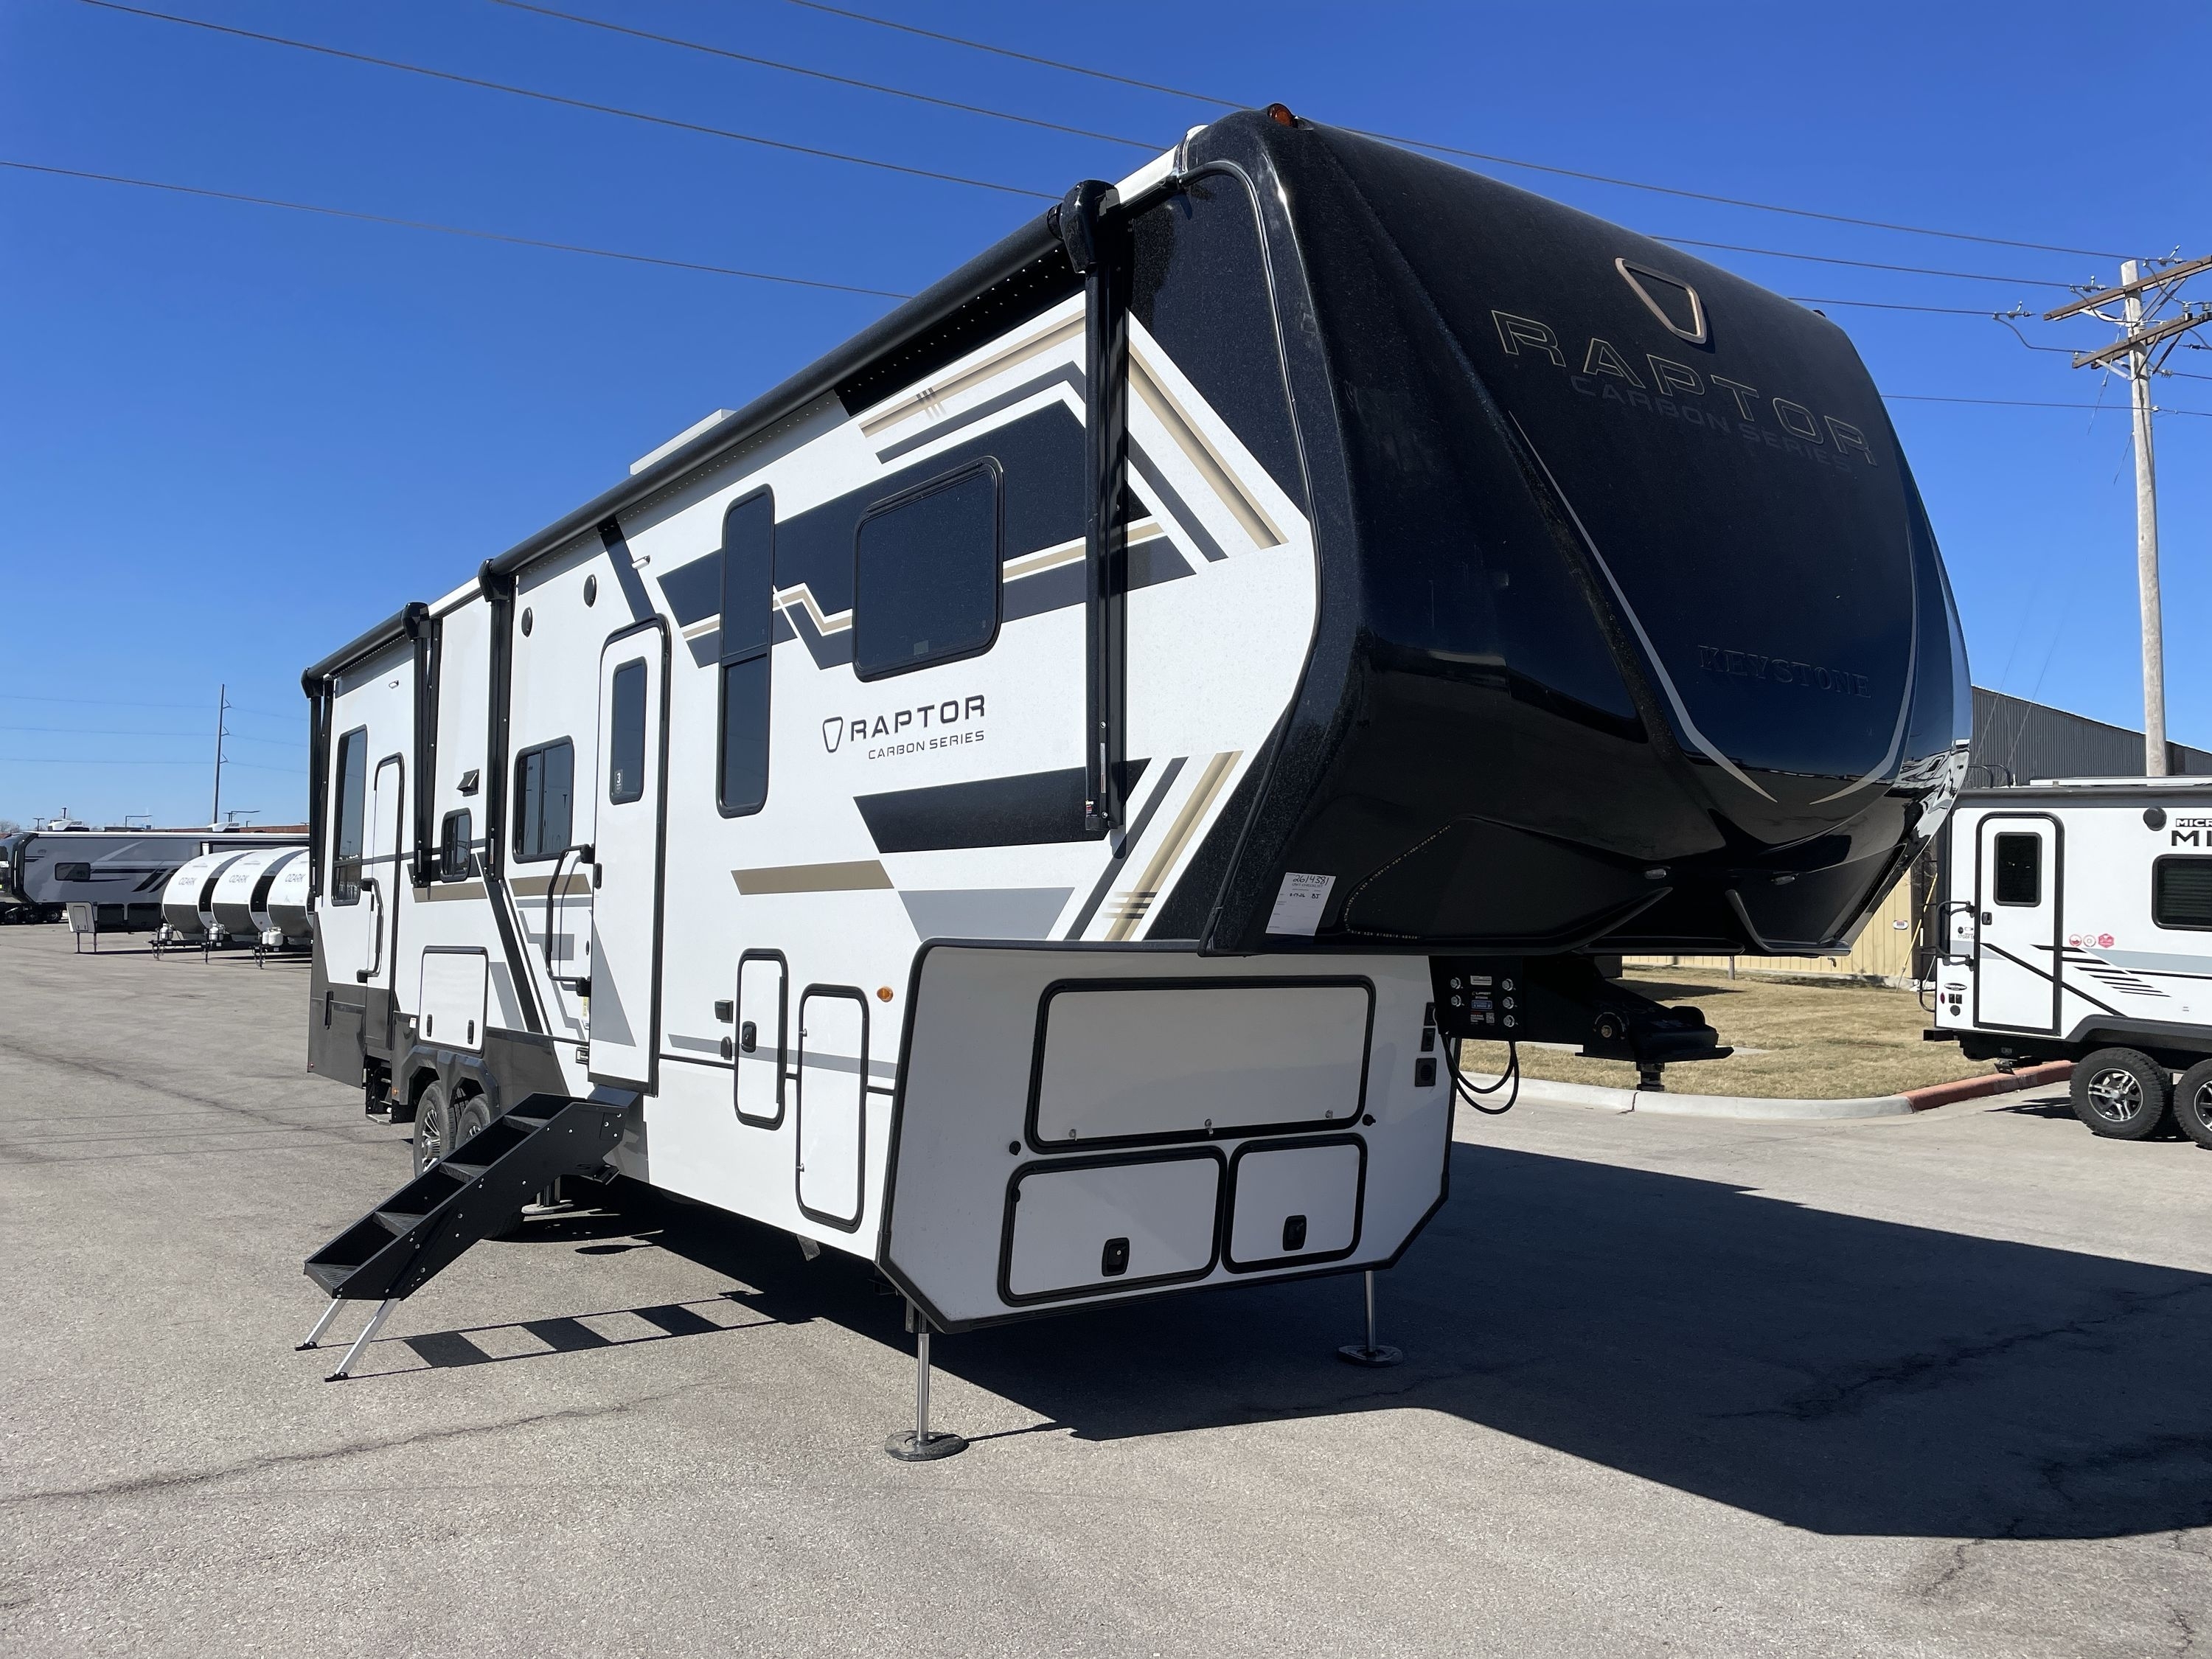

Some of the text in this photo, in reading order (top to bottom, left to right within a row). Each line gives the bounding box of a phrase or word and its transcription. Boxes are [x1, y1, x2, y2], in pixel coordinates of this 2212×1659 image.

[1491, 309, 1877, 467] RAPTOR
[1570, 375, 1852, 473] CARBON SERIES
[1698, 644, 1872, 699] KEYSTONE
[850, 694, 985, 742] RAPTOR
[868, 730, 984, 759] CARBON SERIES
